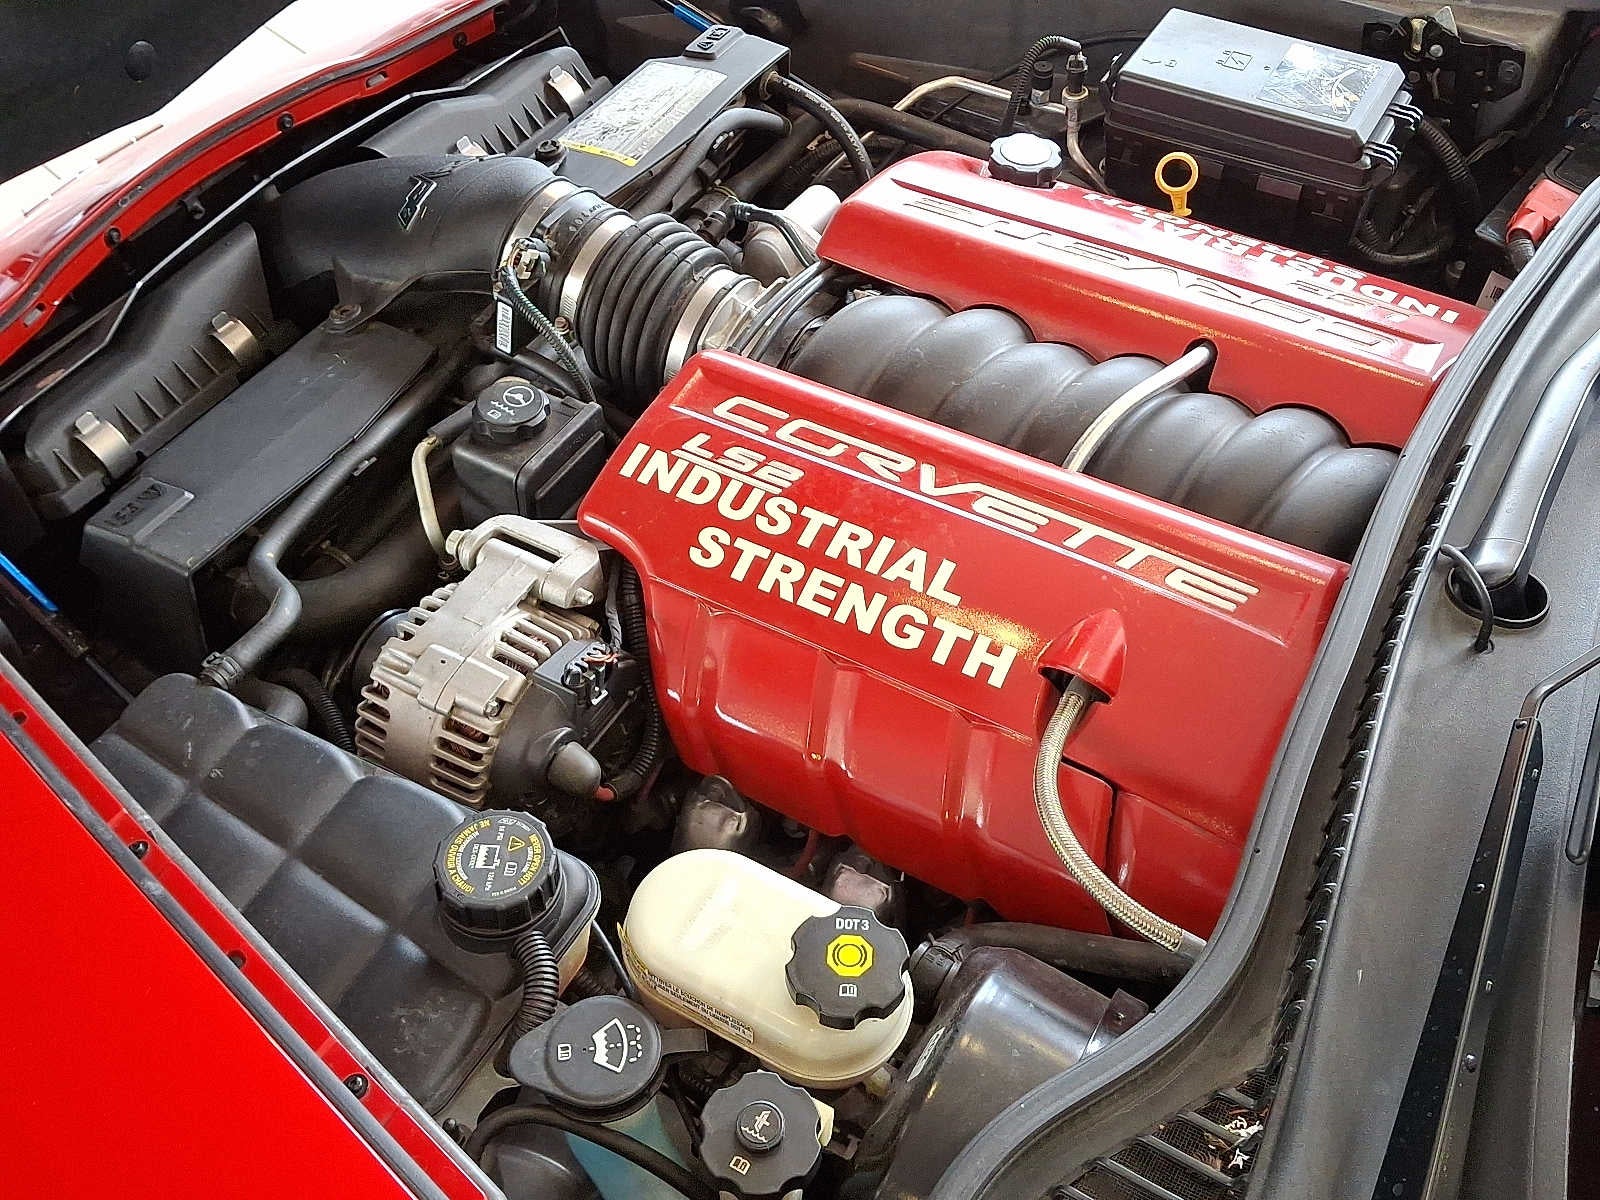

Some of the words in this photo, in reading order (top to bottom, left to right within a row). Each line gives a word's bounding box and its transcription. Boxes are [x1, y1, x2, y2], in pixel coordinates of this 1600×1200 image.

[1131, 212, 1461, 324] INDUSTRIAL
[618, 442, 964, 607] INDUSTRIAL
[711, 394, 1261, 612] CORVETTE
[688, 526, 1021, 689] STRENGTH
[453, 823, 479, 845] JAMAIS
[835, 917, 860, 930] DOT
[861, 919, 870, 931] 3
